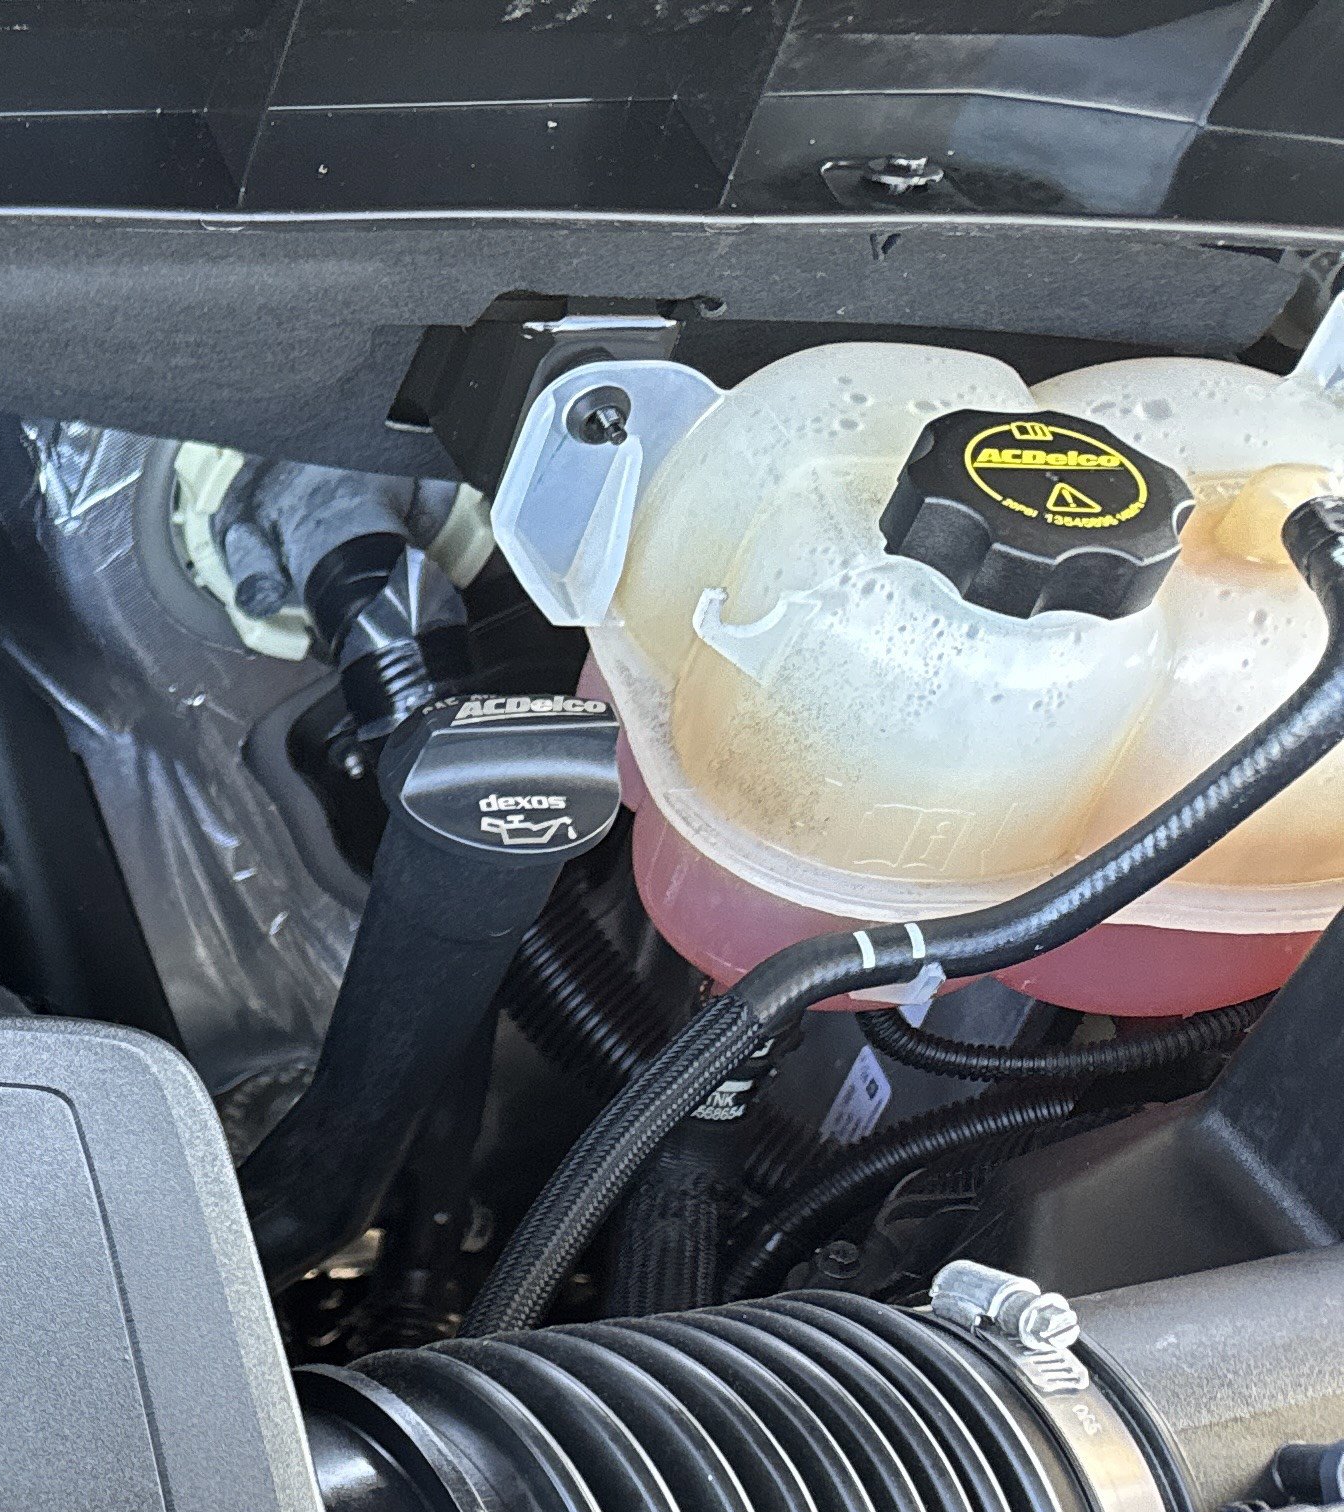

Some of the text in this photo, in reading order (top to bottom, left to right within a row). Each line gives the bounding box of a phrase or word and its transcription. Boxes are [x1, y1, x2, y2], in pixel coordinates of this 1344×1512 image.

[976, 448, 1122, 467] ACDelco
[455, 695, 607, 720] ACDelco
[479, 794, 567, 812] dexos
